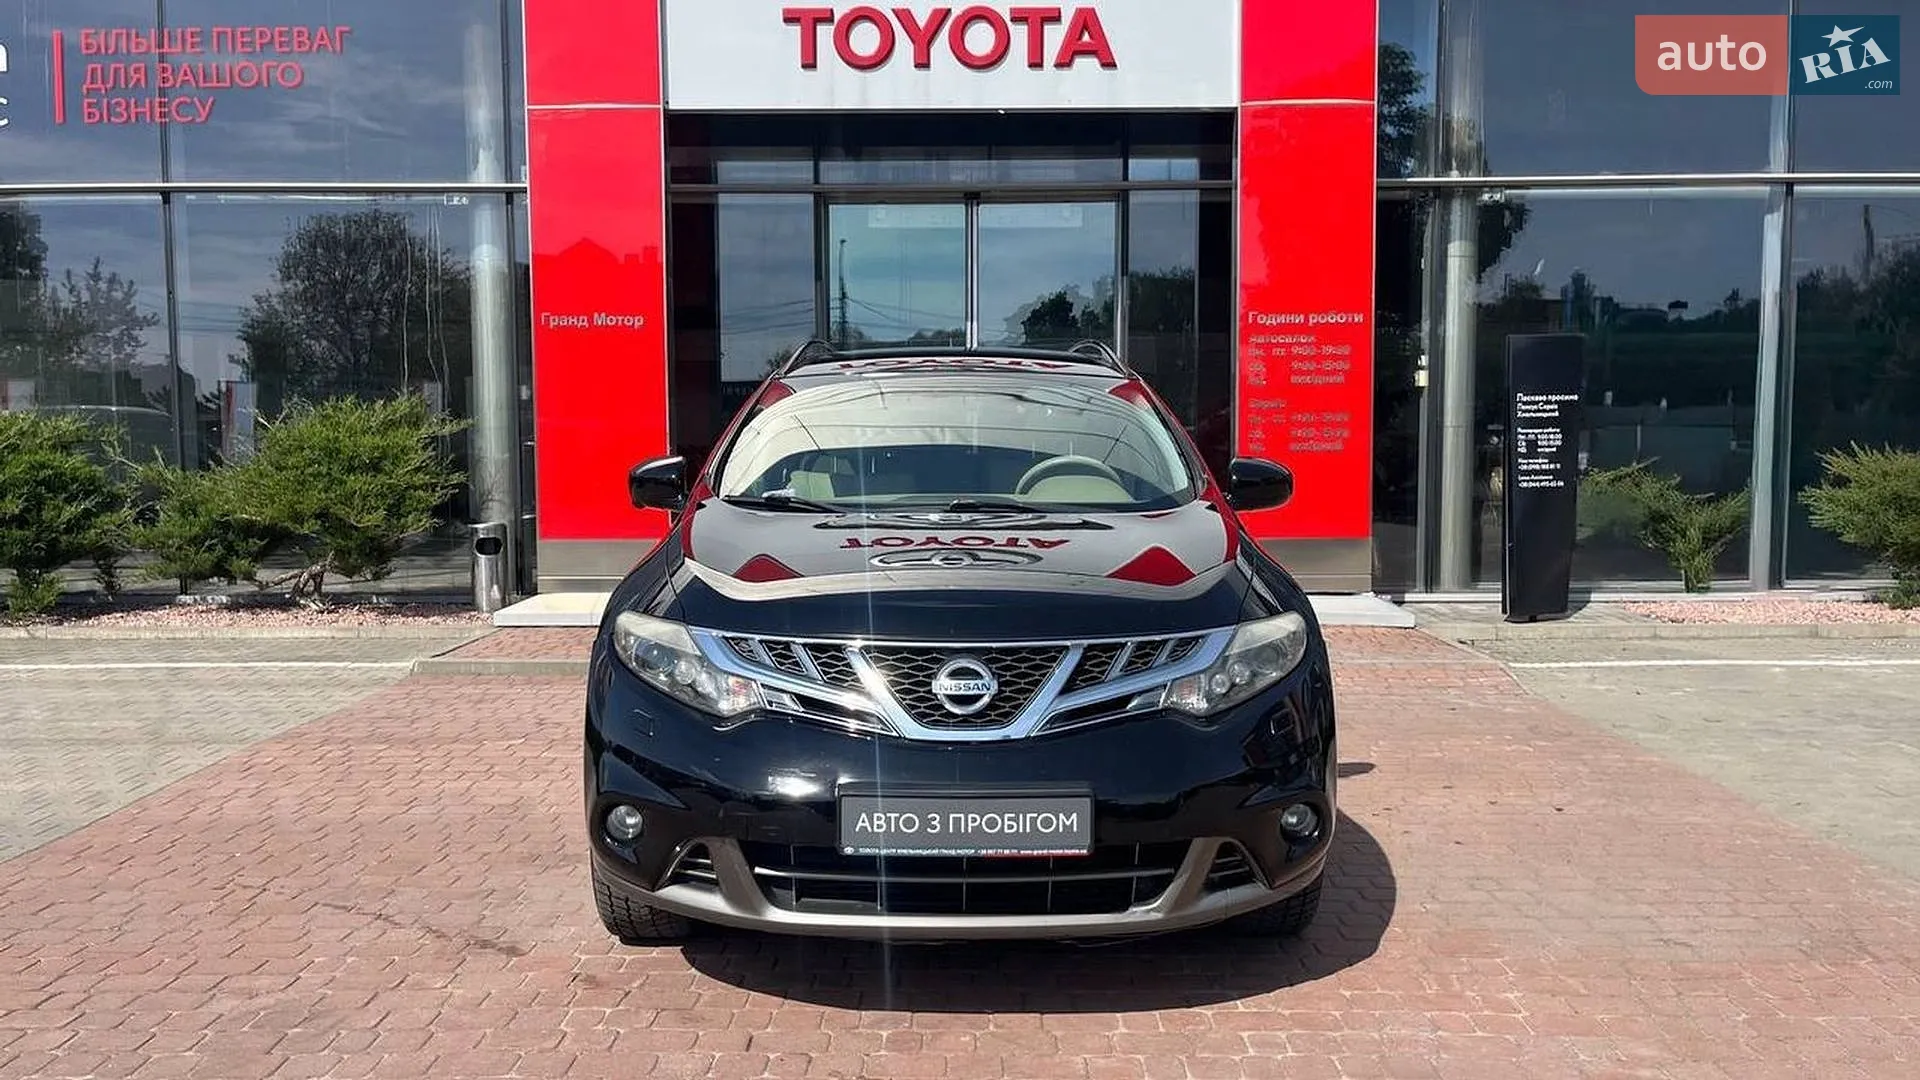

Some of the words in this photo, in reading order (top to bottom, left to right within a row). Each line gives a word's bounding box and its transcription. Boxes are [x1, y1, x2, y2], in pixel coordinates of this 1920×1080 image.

[80, 27, 203, 55] БІЛЬШЕ
[211, 26, 352, 54] ПЕРЕВАГ
[782, 5, 1118, 71] TOYOTA
[82, 63, 147, 93] ДЛЯ
[158, 60, 304, 89] ВАШОГО
[82, 97, 216, 124] БІЗНЕСУ
[541, 312, 589, 329] Гранд
[593, 312, 644, 329] Мотор
[1248, 311, 1305, 326] Години
[1308, 311, 1364, 327] роботи
[939, 682, 991, 692] NISSAN
[855, 812, 920, 833] АВТО
[926, 812, 941, 833] З
[949, 812, 1077, 833] ПРОБІГОМ
